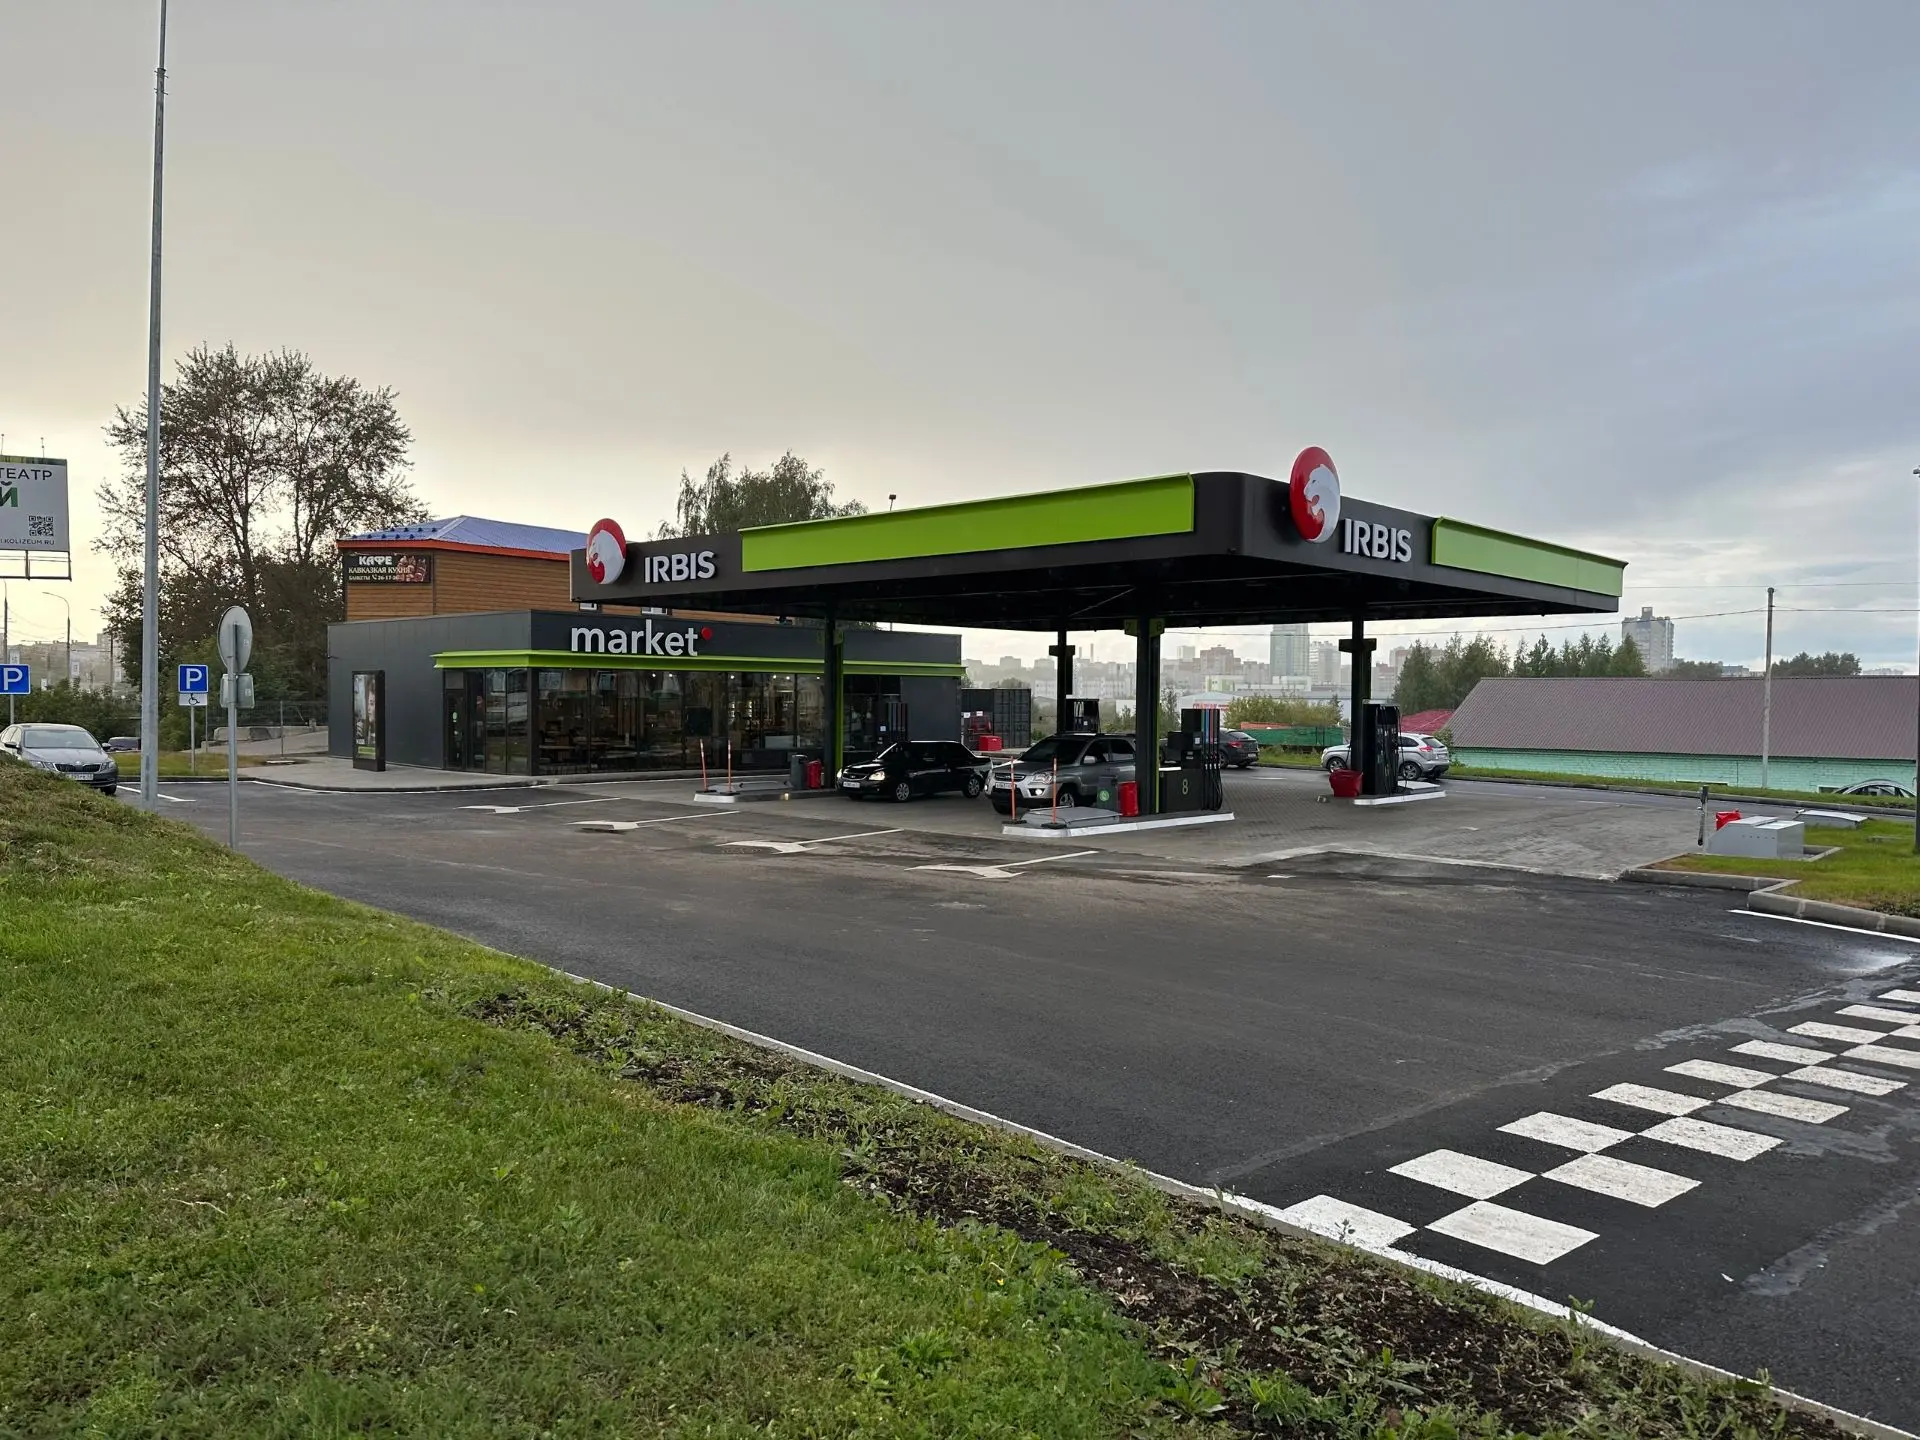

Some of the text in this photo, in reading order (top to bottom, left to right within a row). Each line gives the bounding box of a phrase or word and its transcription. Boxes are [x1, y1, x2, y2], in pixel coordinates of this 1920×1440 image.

[1343, 518, 1412, 562] IRBIS
[358, 556, 393, 566] КАФЕ
[644, 550, 717, 583] IRBIS
[571, 619, 699, 657] market
[3, 668, 23, 691] P
[185, 668, 202, 690] P
[1182, 778, 1189, 795] 8
